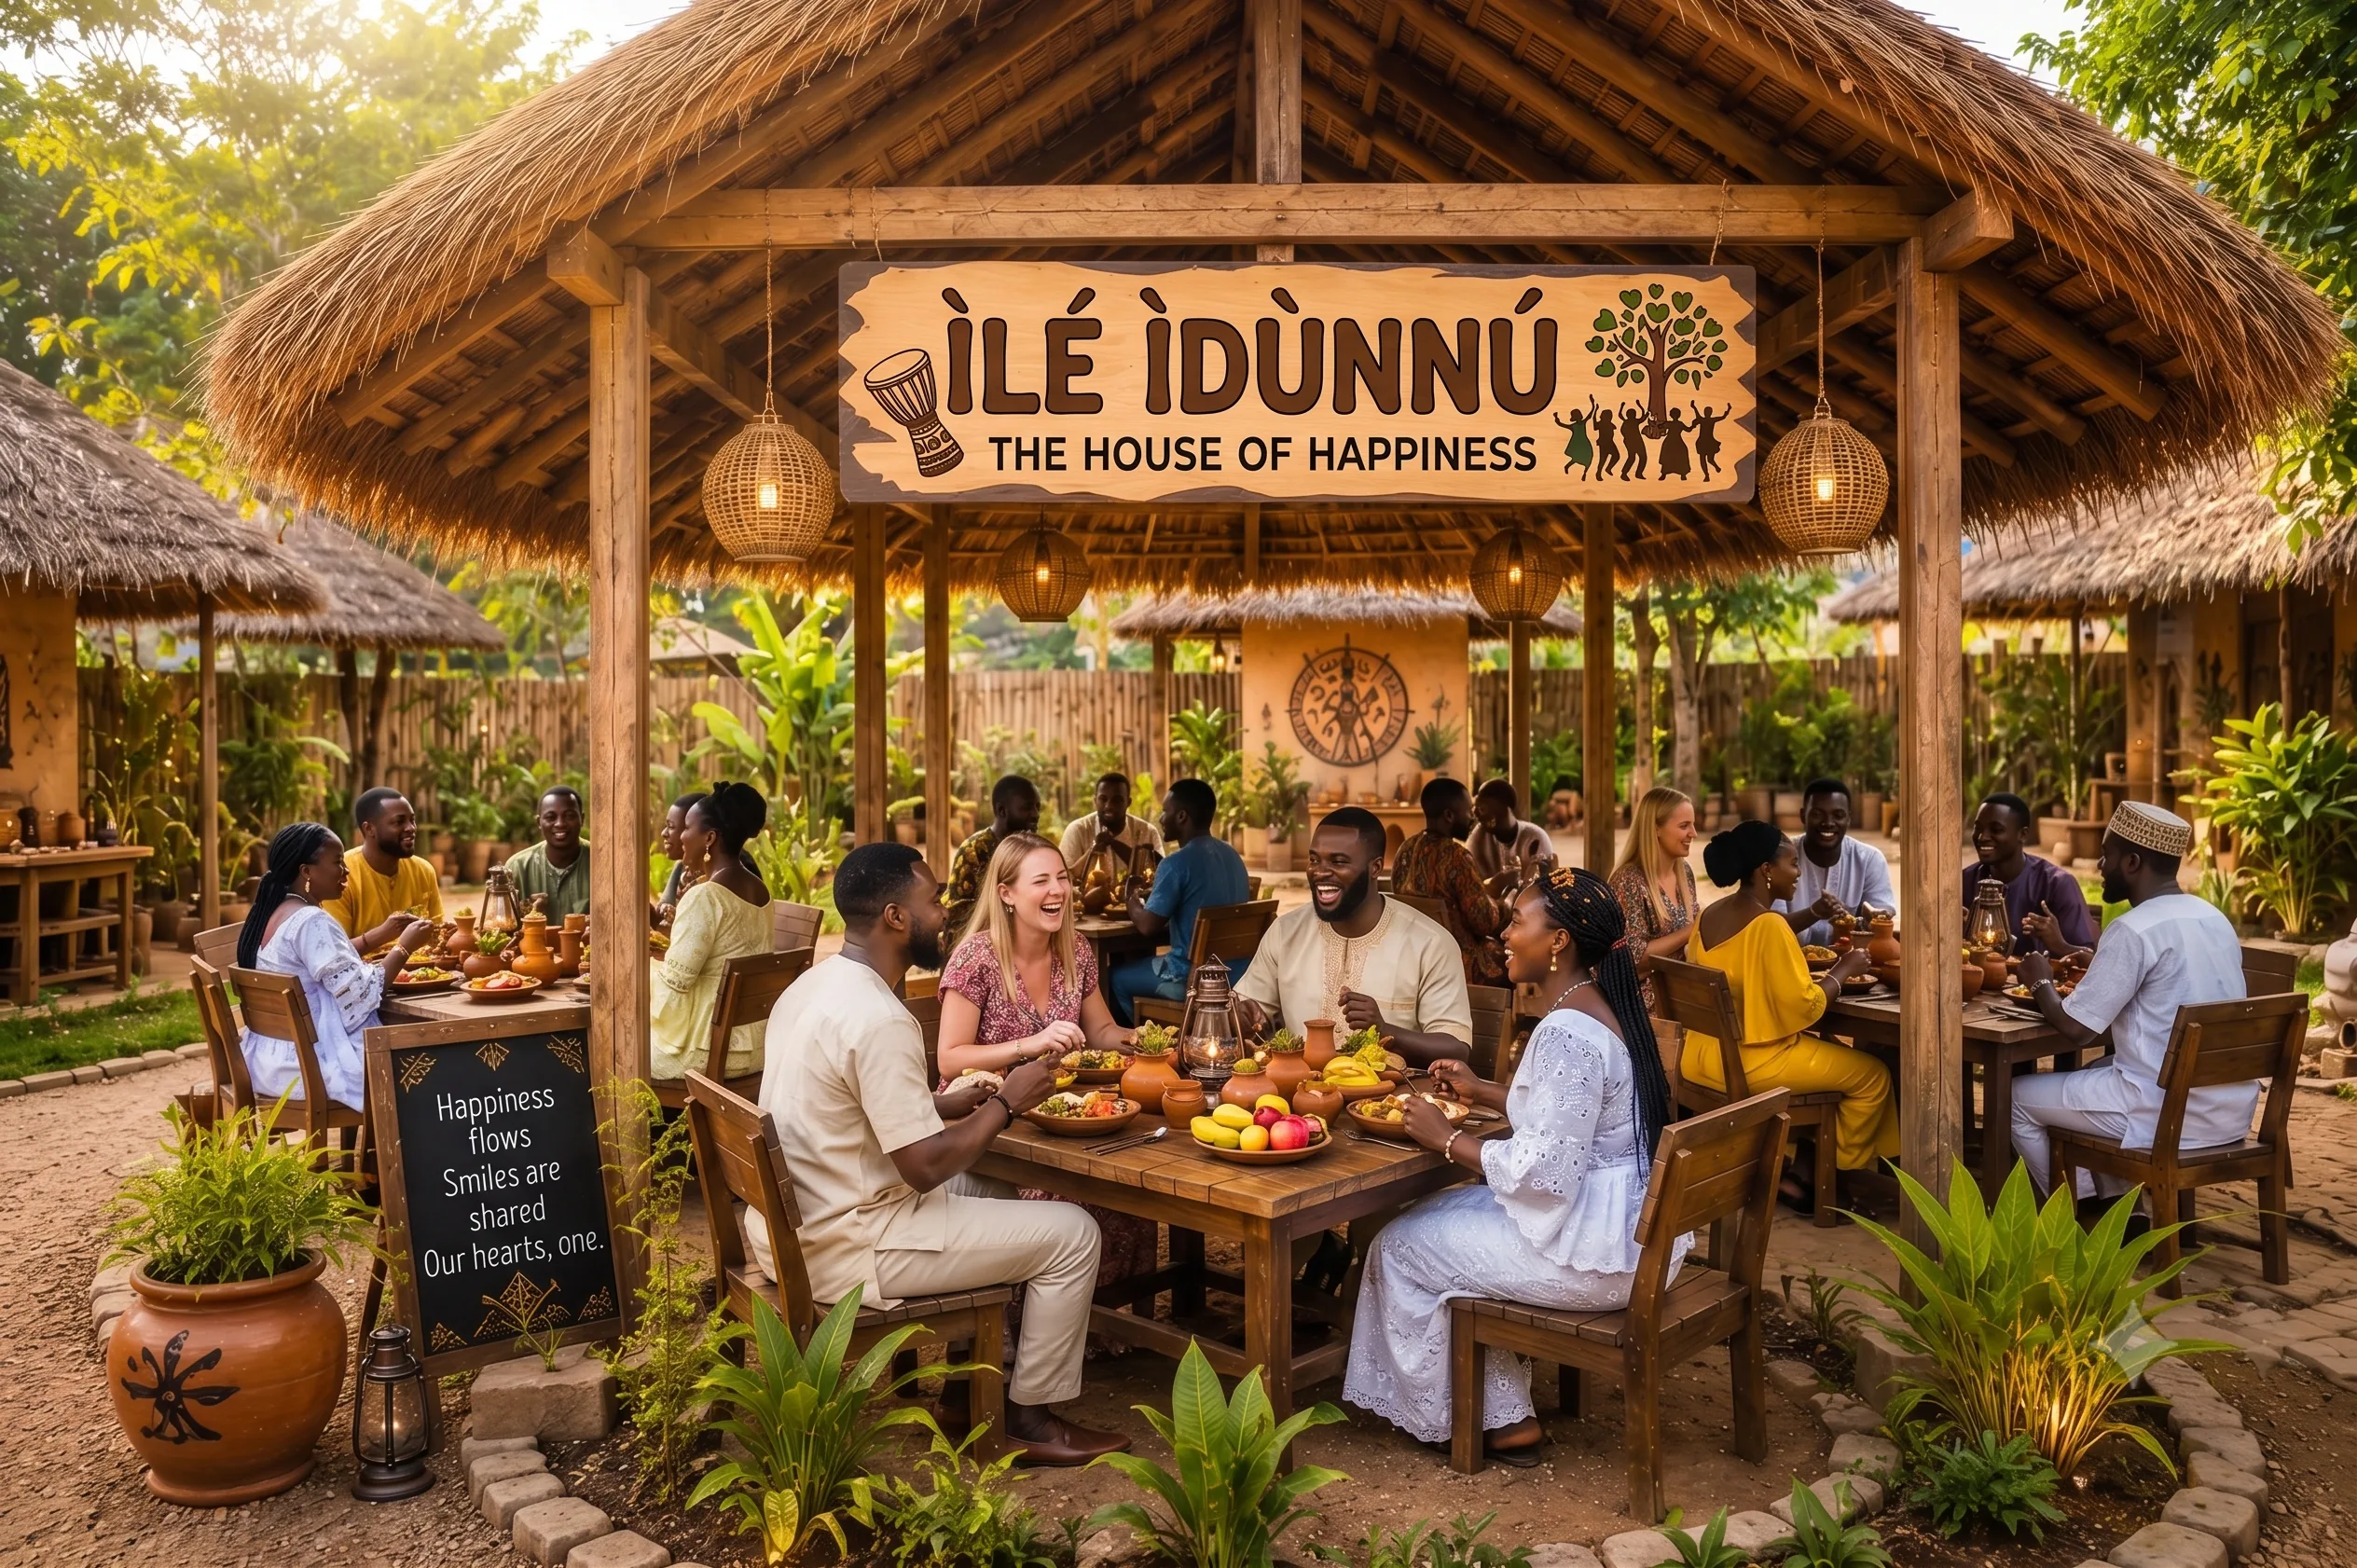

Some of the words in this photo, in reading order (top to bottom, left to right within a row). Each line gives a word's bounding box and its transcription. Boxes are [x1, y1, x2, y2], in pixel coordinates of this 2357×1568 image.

[941, 286, 1104, 416] ÌLÉ
[1138, 286, 1559, 416] ÌDÙNNÚ
[988, 436, 1068, 472] THE
[1084, 435, 1222, 472] HOUSE
[1238, 435, 1292, 472] OF
[1309, 435, 1537, 472] HAPPINESS
[436, 1087, 555, 1125] Happiness
[468, 1126, 531, 1155] flows
[443, 1162, 519, 1197] Smiles
[526, 1161, 561, 1185] are
[469, 1193, 545, 1232] shared
[423, 1248, 466, 1278] Our
[472, 1235, 554, 1271] hearts,
[558, 1231, 605, 1256] one.
